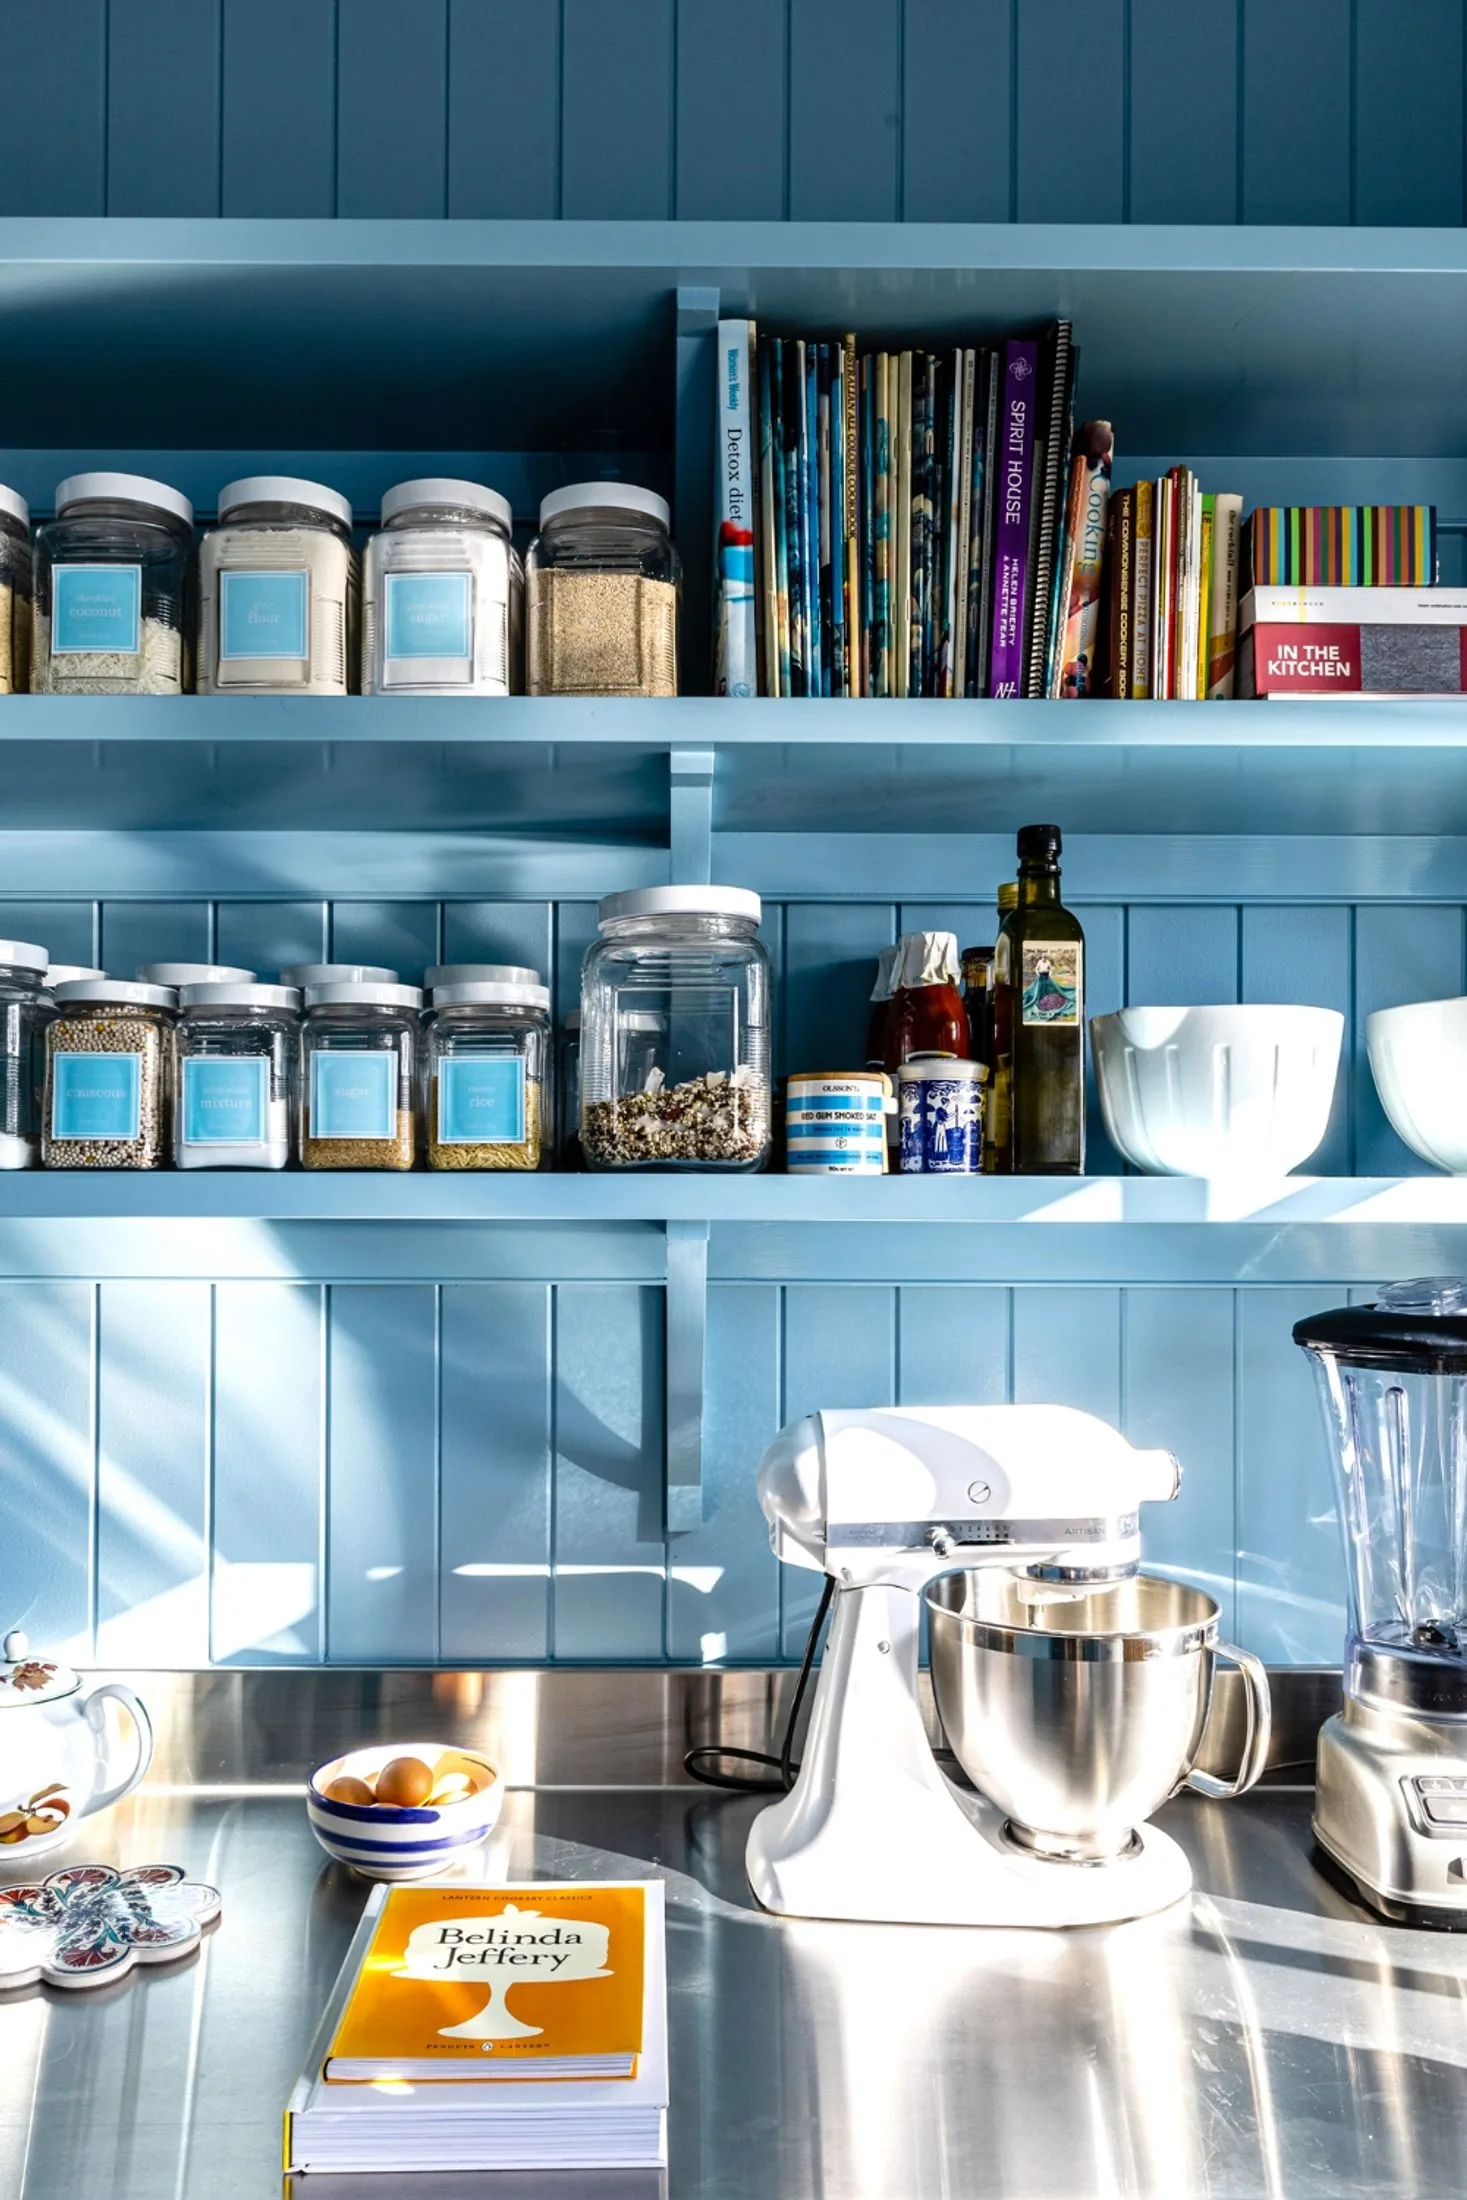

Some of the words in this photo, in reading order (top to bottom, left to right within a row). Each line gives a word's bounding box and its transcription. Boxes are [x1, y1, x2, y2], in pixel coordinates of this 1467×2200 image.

[727, 348, 740, 383] Women's
[846, 340, 856, 411] AUSTRALIAN
[727, 384, 740, 411] Weekly
[847, 412, 857, 431] ALL
[1008, 400, 1027, 456] SPIRIT
[727, 428, 743, 481] Detox
[847, 432, 857, 477] COLOUR
[728, 487, 744, 521] diet
[1005, 459, 1023, 525] HOUSE
[1122, 494, 1131, 517] THE
[1077, 473, 1110, 577] Cooking
[1229, 510, 1237, 525] the
[1227, 527, 1236, 567] cocktail
[1011, 558, 1019, 595] HELEN
[1120, 519, 1130, 611] COMMONSENSE
[1137, 541, 1149, 589] PERFECT
[1000, 563, 1010, 616] ANNETTE
[68, 606, 123, 618] coconut
[247, 609, 281, 624] flour
[1008, 597, 1018, 647] BRIERTY
[1136, 593, 1148, 626] PIZZA
[999, 617, 1008, 648] FEAR
[1119, 612, 1128, 668] COOKERY
[1136, 631, 1147, 645] AT
[1135, 650, 1147, 683] HOME
[1268, 660, 1351, 677] KITCHEN
[1277, 645, 1298, 660] IN
[1302, 645, 1340, 660] THE
[200, 1098, 252, 1109] mixture
[335, 1087, 369, 1099] sugar
[469, 1095, 496, 1108] rice
[801, 1111, 815, 1121] RED
[816, 1111, 832, 1121] GUM
[834, 1111, 865, 1121] SMOKED
[434, 1927, 583, 1945] Belinda
[433, 1946, 571, 1972] Jeffery
